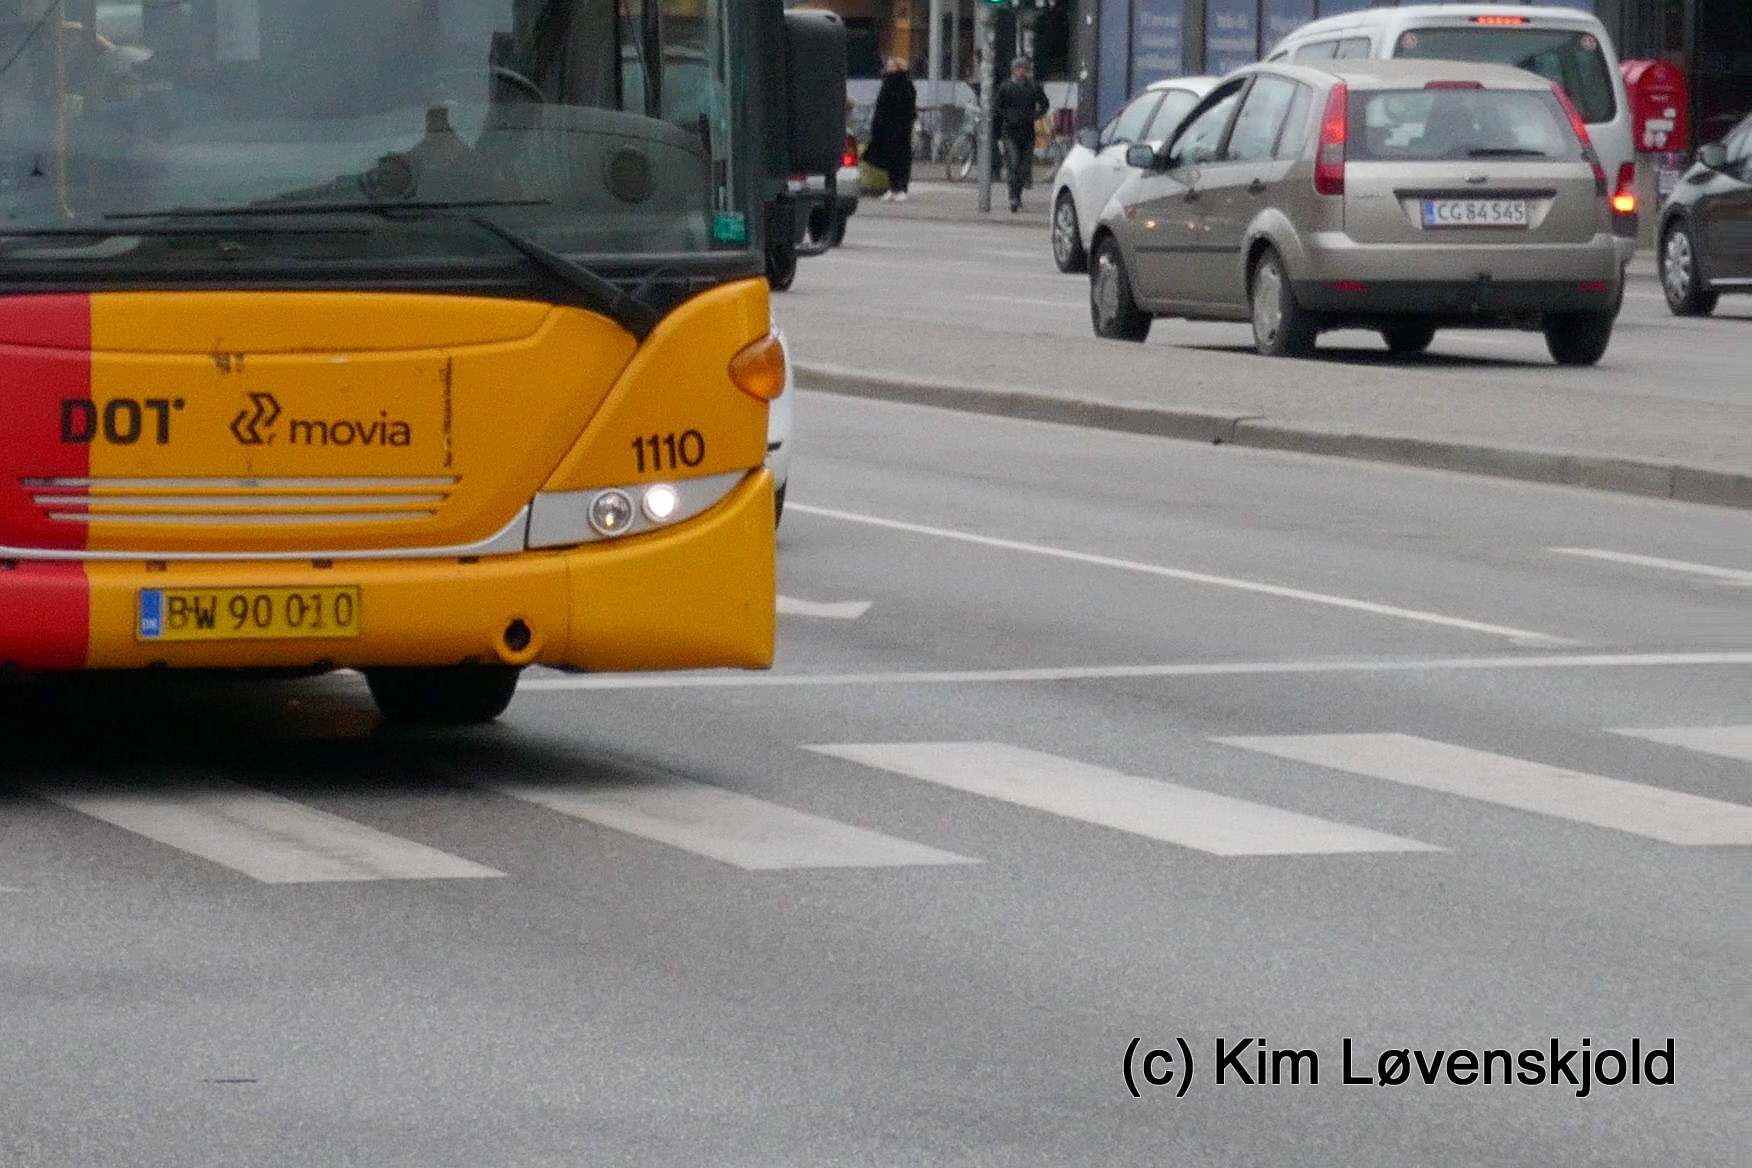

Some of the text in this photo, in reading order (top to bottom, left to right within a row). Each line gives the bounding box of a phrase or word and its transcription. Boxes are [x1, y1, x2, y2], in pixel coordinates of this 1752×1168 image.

[1437, 201, 1462, 221] CG
[60, 398, 185, 445] DOT
[289, 409, 410, 446] movia
[631, 430, 705, 473] 1110
[229, 594, 272, 629] 90
